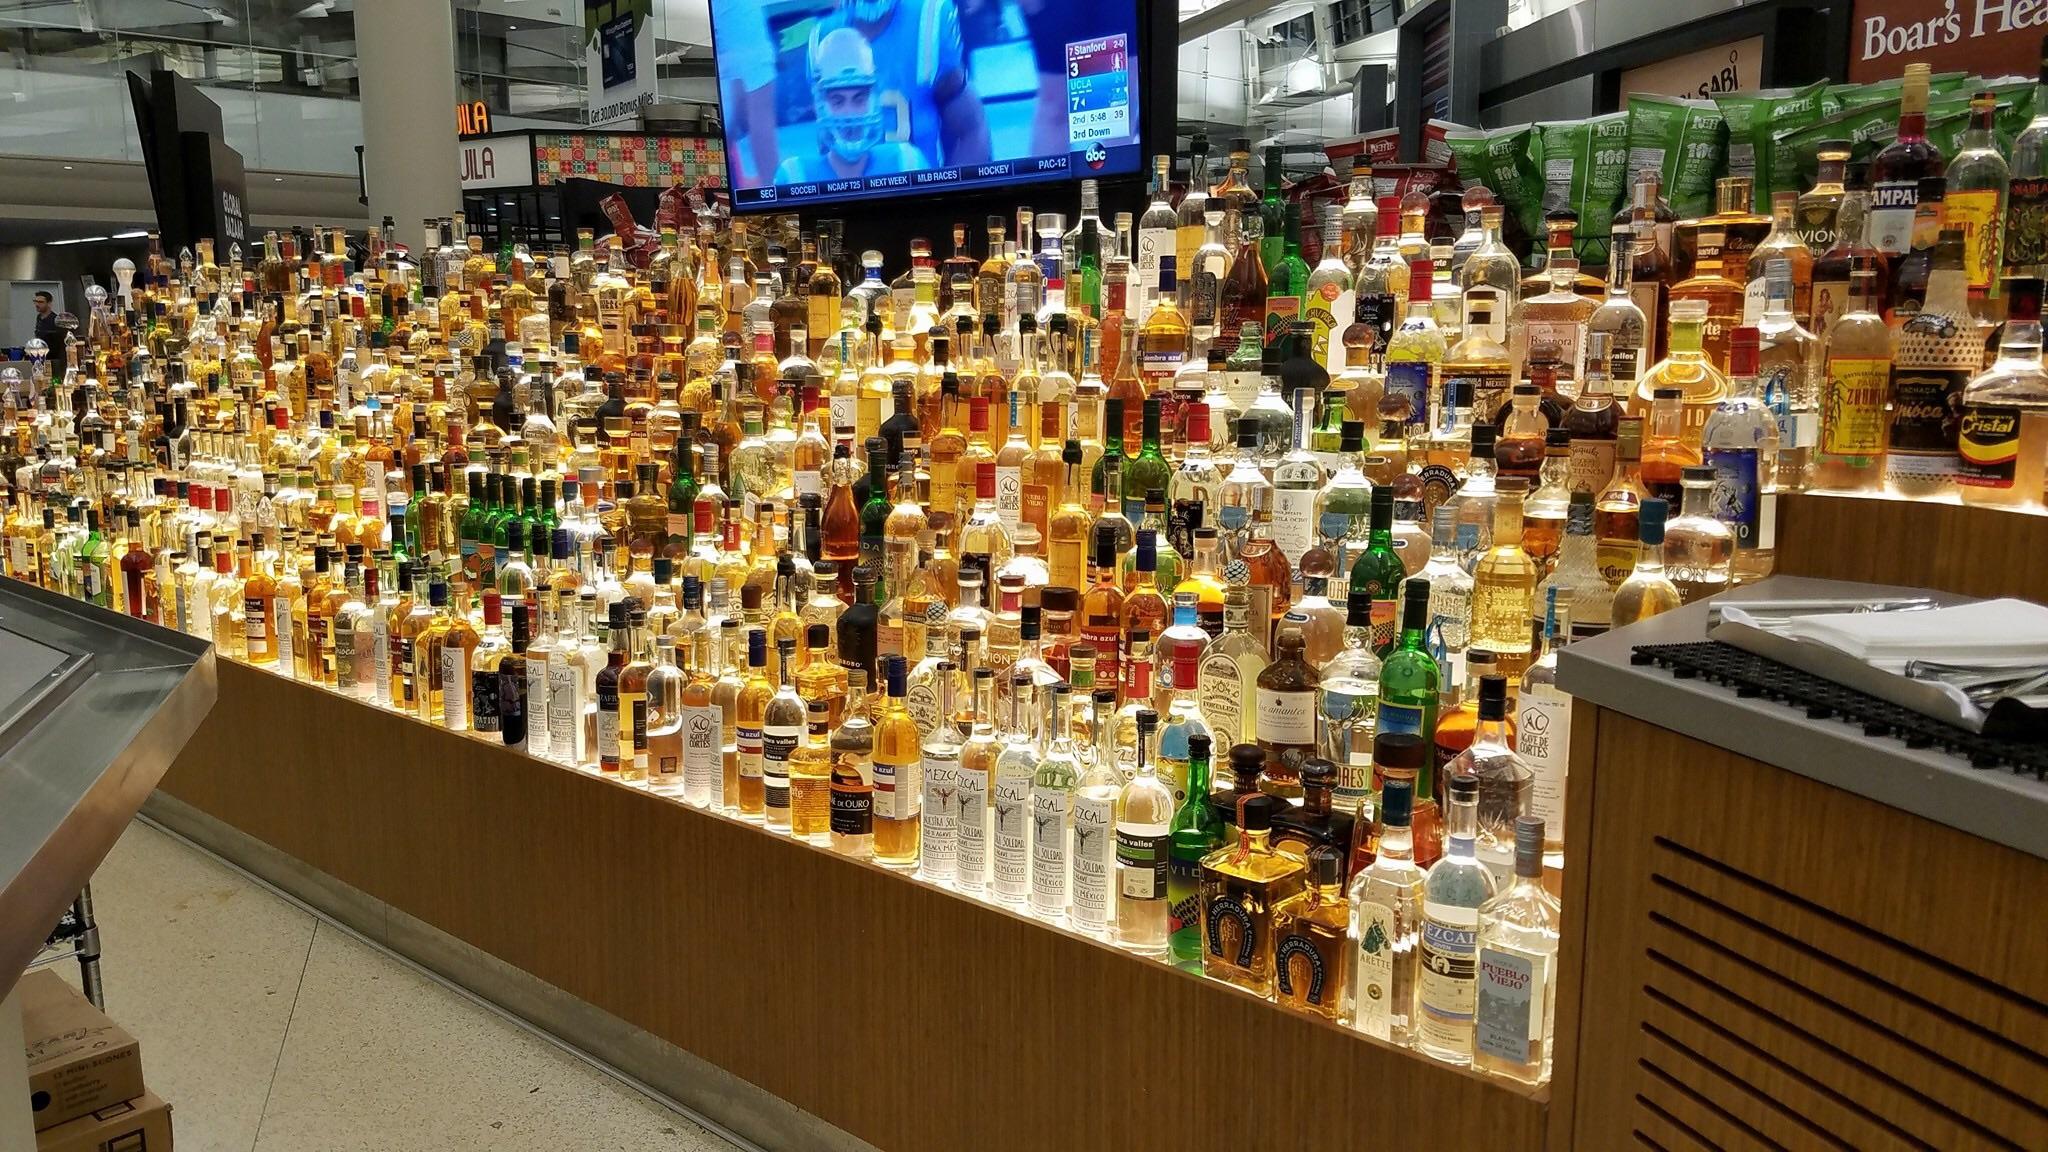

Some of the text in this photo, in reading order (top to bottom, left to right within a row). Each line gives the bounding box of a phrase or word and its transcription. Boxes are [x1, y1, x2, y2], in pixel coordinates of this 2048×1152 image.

[1863, 0, 1961, 60] Boar's
[1069, 40, 1124, 56] 7 Stanford 2-0
[1070, 62, 1079, 77] 3
[1070, 79, 1092, 90] UCLA
[591, 92, 654, 124] Get 30,000 Bonus Miles
[1072, 97, 1080, 110] 7
[1072, 110, 1124, 125] 2nd 5:48 39
[1073, 127, 1111, 139] 3rd Down
[1085, 150, 1106, 162] abc
[760, 158, 1066, 199] SEC SOCCER NCAAF T25 NEXT WEEK MLB RACES HOCKEY PAC-12
[1872, 189, 1918, 206] AMPA
[1961, 413, 2015, 435] Cristal
[1099, 634, 1117, 642] azul
[1267, 705, 1306, 716] amantes
[1525, 717, 1545, 732] AC
[689, 739, 711, 748] CORTES
[1538, 734, 1549, 748] DE
[1520, 743, 1549, 758] CORTES
[880, 766, 894, 775] azul
[846, 799, 870, 809] OURO
[1129, 840, 1153, 848] valles
[1211, 901, 1251, 929] HERRADURA
[1281, 940, 1321, 967] HERRADURA
[1360, 953, 1391, 970] ARETTE
[1481, 961, 1530, 984] PUEBLO
[1488, 972, 1523, 990] VIEJO
